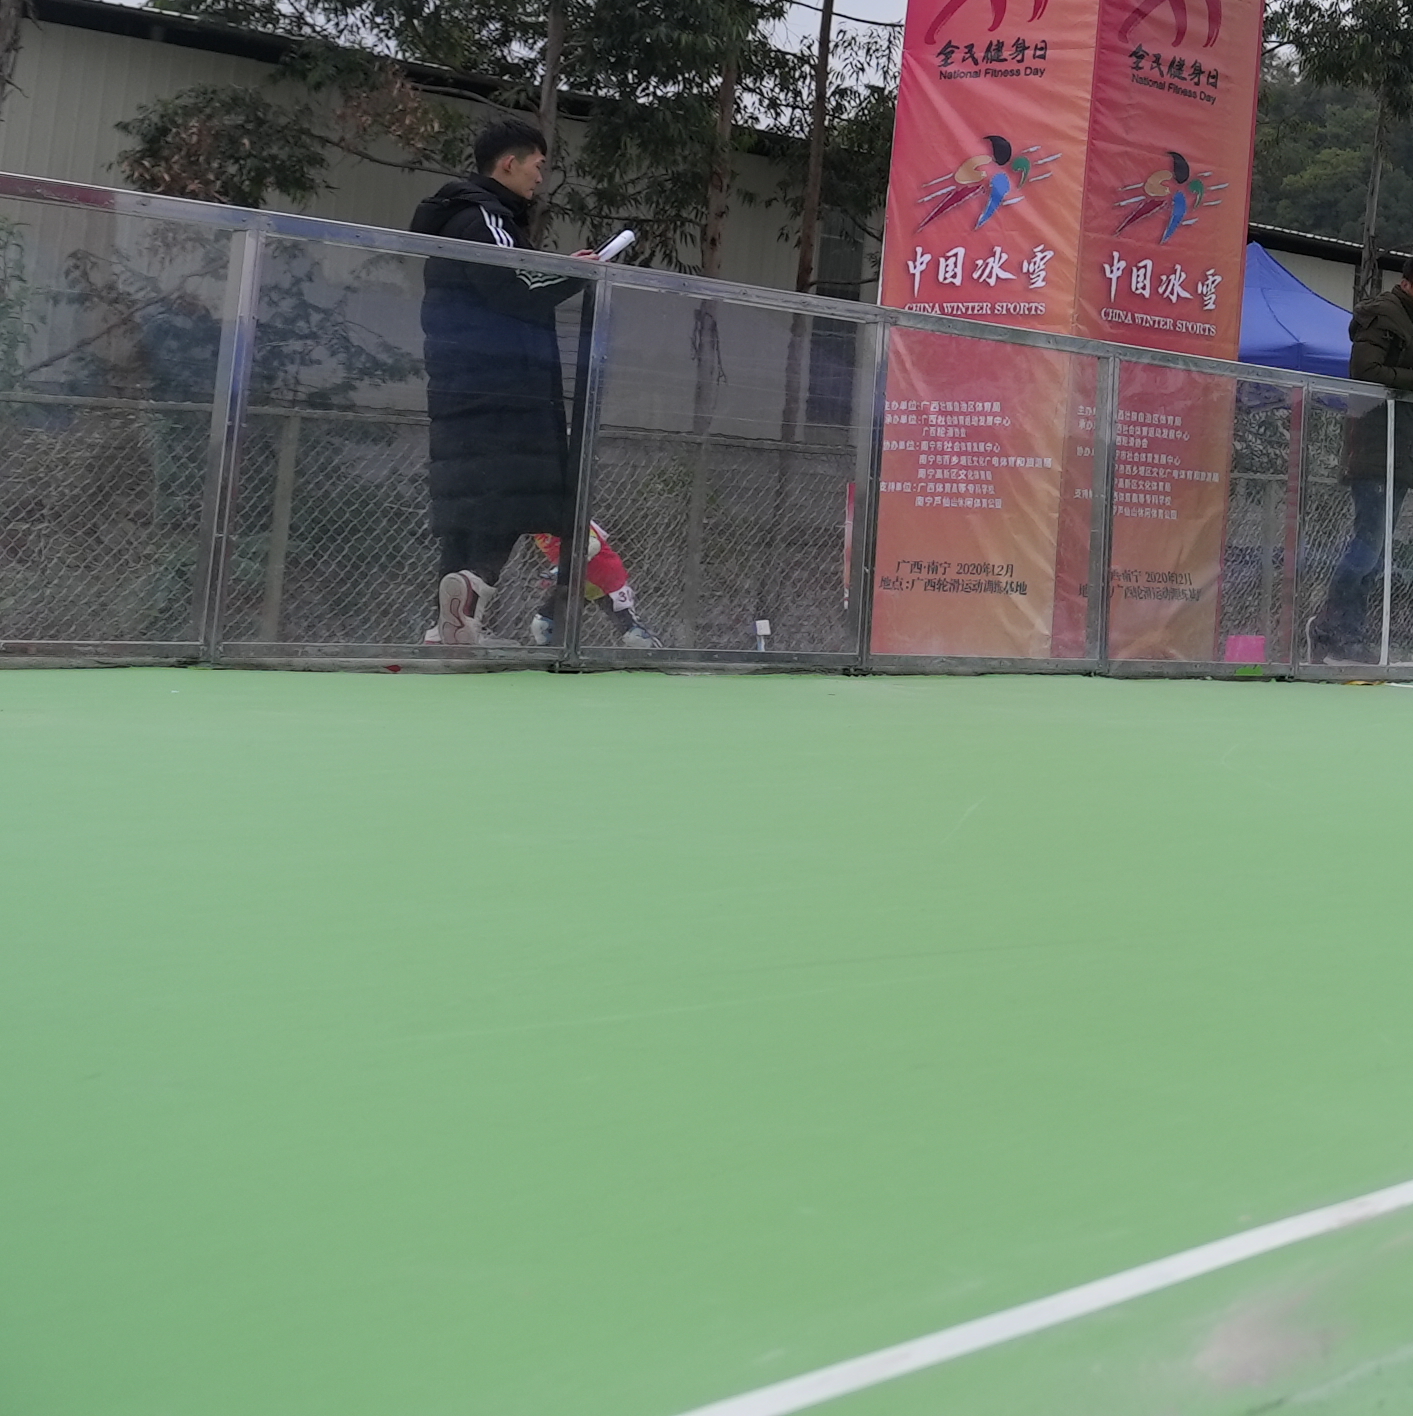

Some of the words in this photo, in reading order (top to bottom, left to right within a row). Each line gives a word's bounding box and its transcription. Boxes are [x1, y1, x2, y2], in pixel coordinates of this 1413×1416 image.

[939, 69, 981, 80] National
[984, 67, 1020, 78] Fitness
[1023, 66, 1046, 79] Day
[1131, 73, 1166, 91] National
[1199, 90, 1217, 106] Day
[906, 243, 1055, 298] 中国冰雪
[1102, 250, 1223, 310] 中国冰雪
[904, 302, 942, 315] CHINA
[943, 302, 992, 315] WINTER
[994, 302, 1046, 315] SPORTS
[1101, 307, 1133, 324] CHINA
[1134, 313, 1174, 331] WINTER
[1175, 320, 1217, 336] SPORTS
